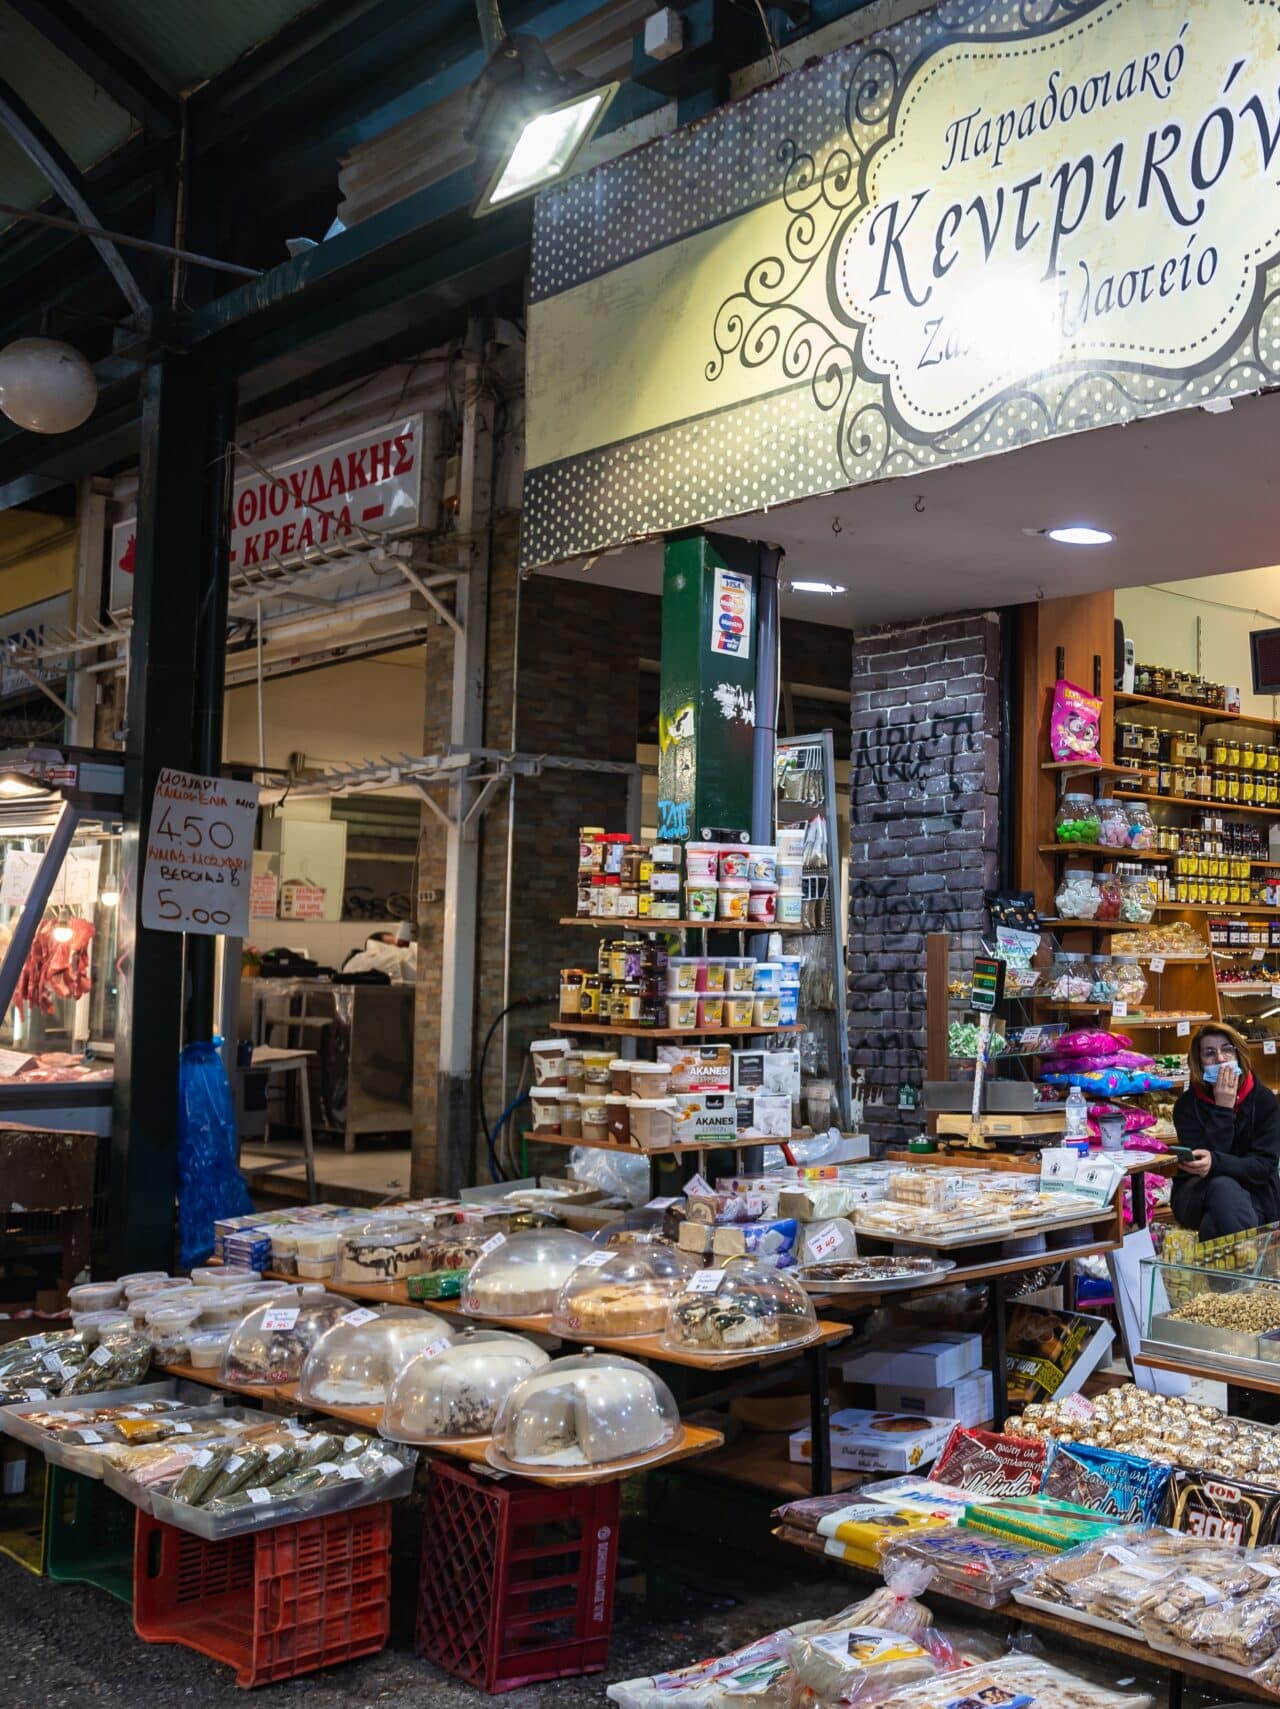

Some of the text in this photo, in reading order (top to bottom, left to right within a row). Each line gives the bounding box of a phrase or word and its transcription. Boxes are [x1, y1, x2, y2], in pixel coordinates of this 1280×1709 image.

[942, 24, 1189, 172] Παραδοσιακό
[916, 234, 1219, 369] Ζαλαστείο
[244, 506, 352, 567] ΚΡΕΑΤΑ
[157, 888, 231, 925] 5.00
[696, 1117, 735, 1126] AKANES
[1208, 1485, 1236, 1500] ION
